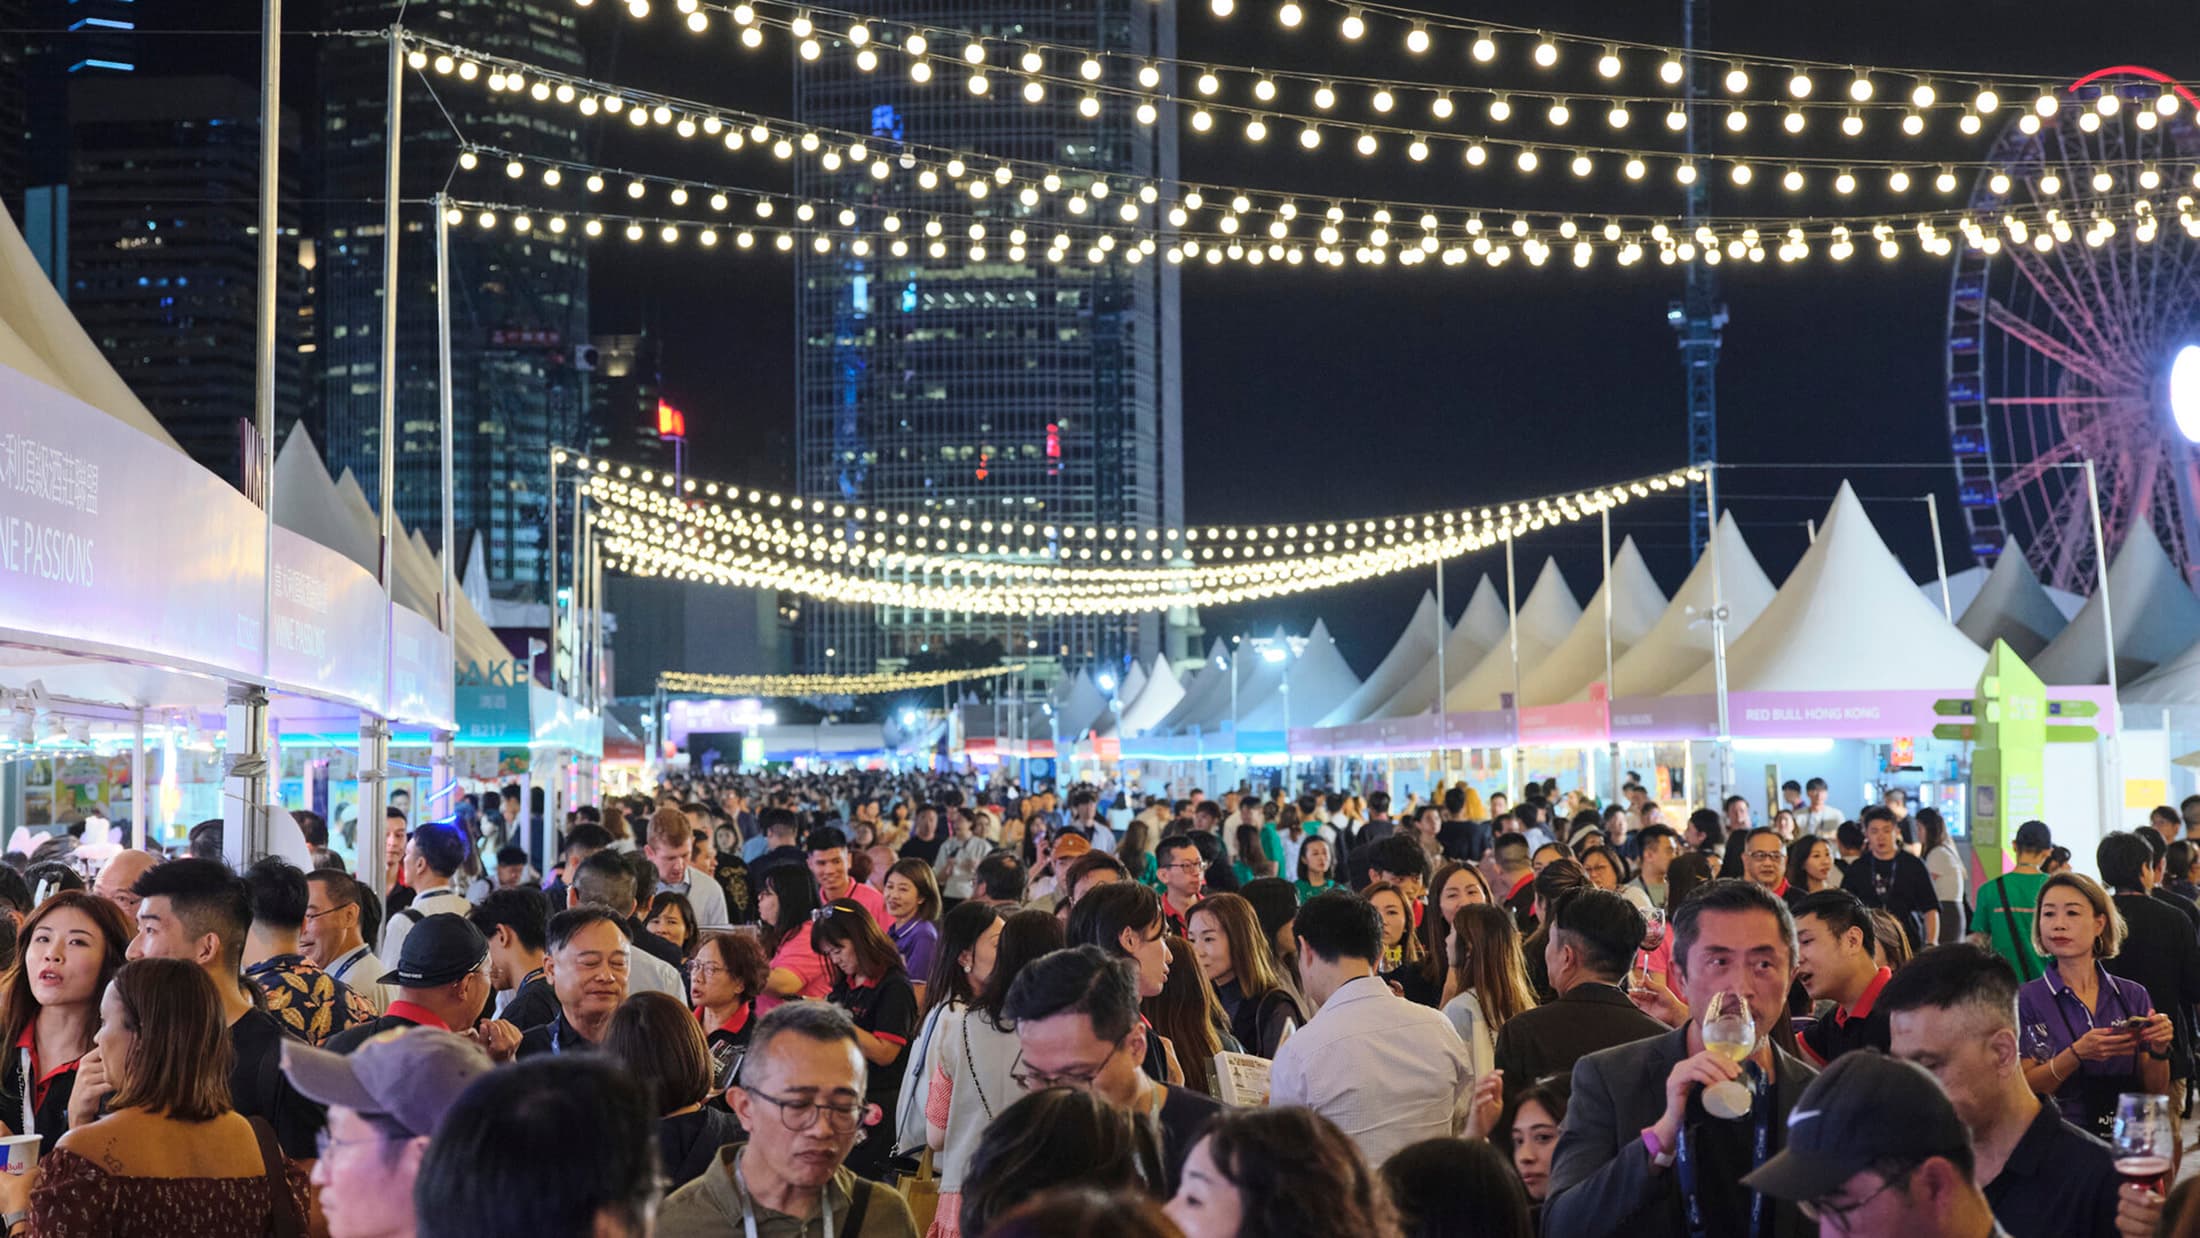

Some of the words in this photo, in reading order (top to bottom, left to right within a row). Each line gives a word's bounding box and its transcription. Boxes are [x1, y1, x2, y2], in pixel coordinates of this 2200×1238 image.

[24, 521, 94, 588] PASSIONS
[1745, 708, 1770, 721] RED
[1772, 708, 1803, 721] BULL
[1805, 707, 1842, 720] HONG
[1844, 706, 1880, 720] KONG
